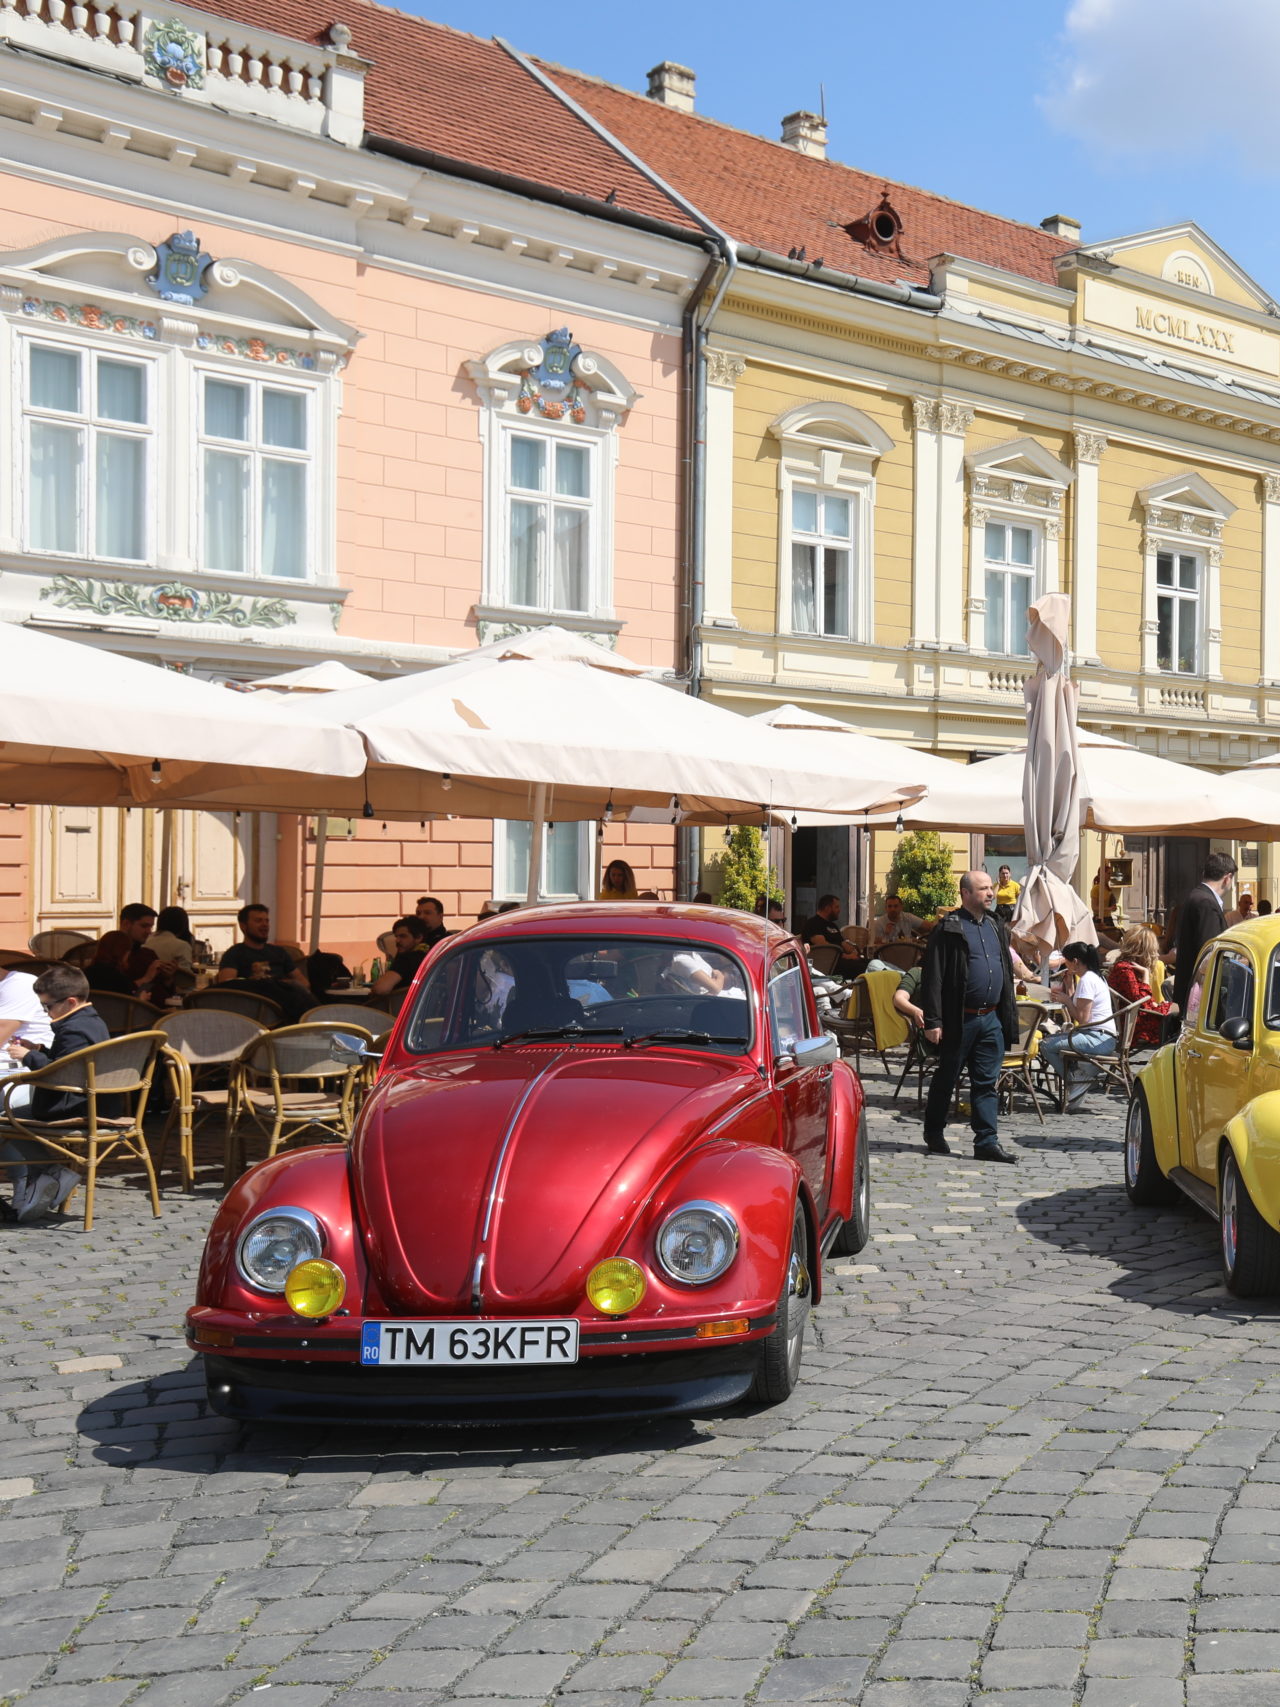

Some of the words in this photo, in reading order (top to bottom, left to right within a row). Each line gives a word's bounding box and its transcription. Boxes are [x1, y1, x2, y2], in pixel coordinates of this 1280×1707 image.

[1136, 305, 1235, 353] MCMLXXX
[363, 1347, 379, 1359] RO
[385, 1328, 435, 1359] TM
